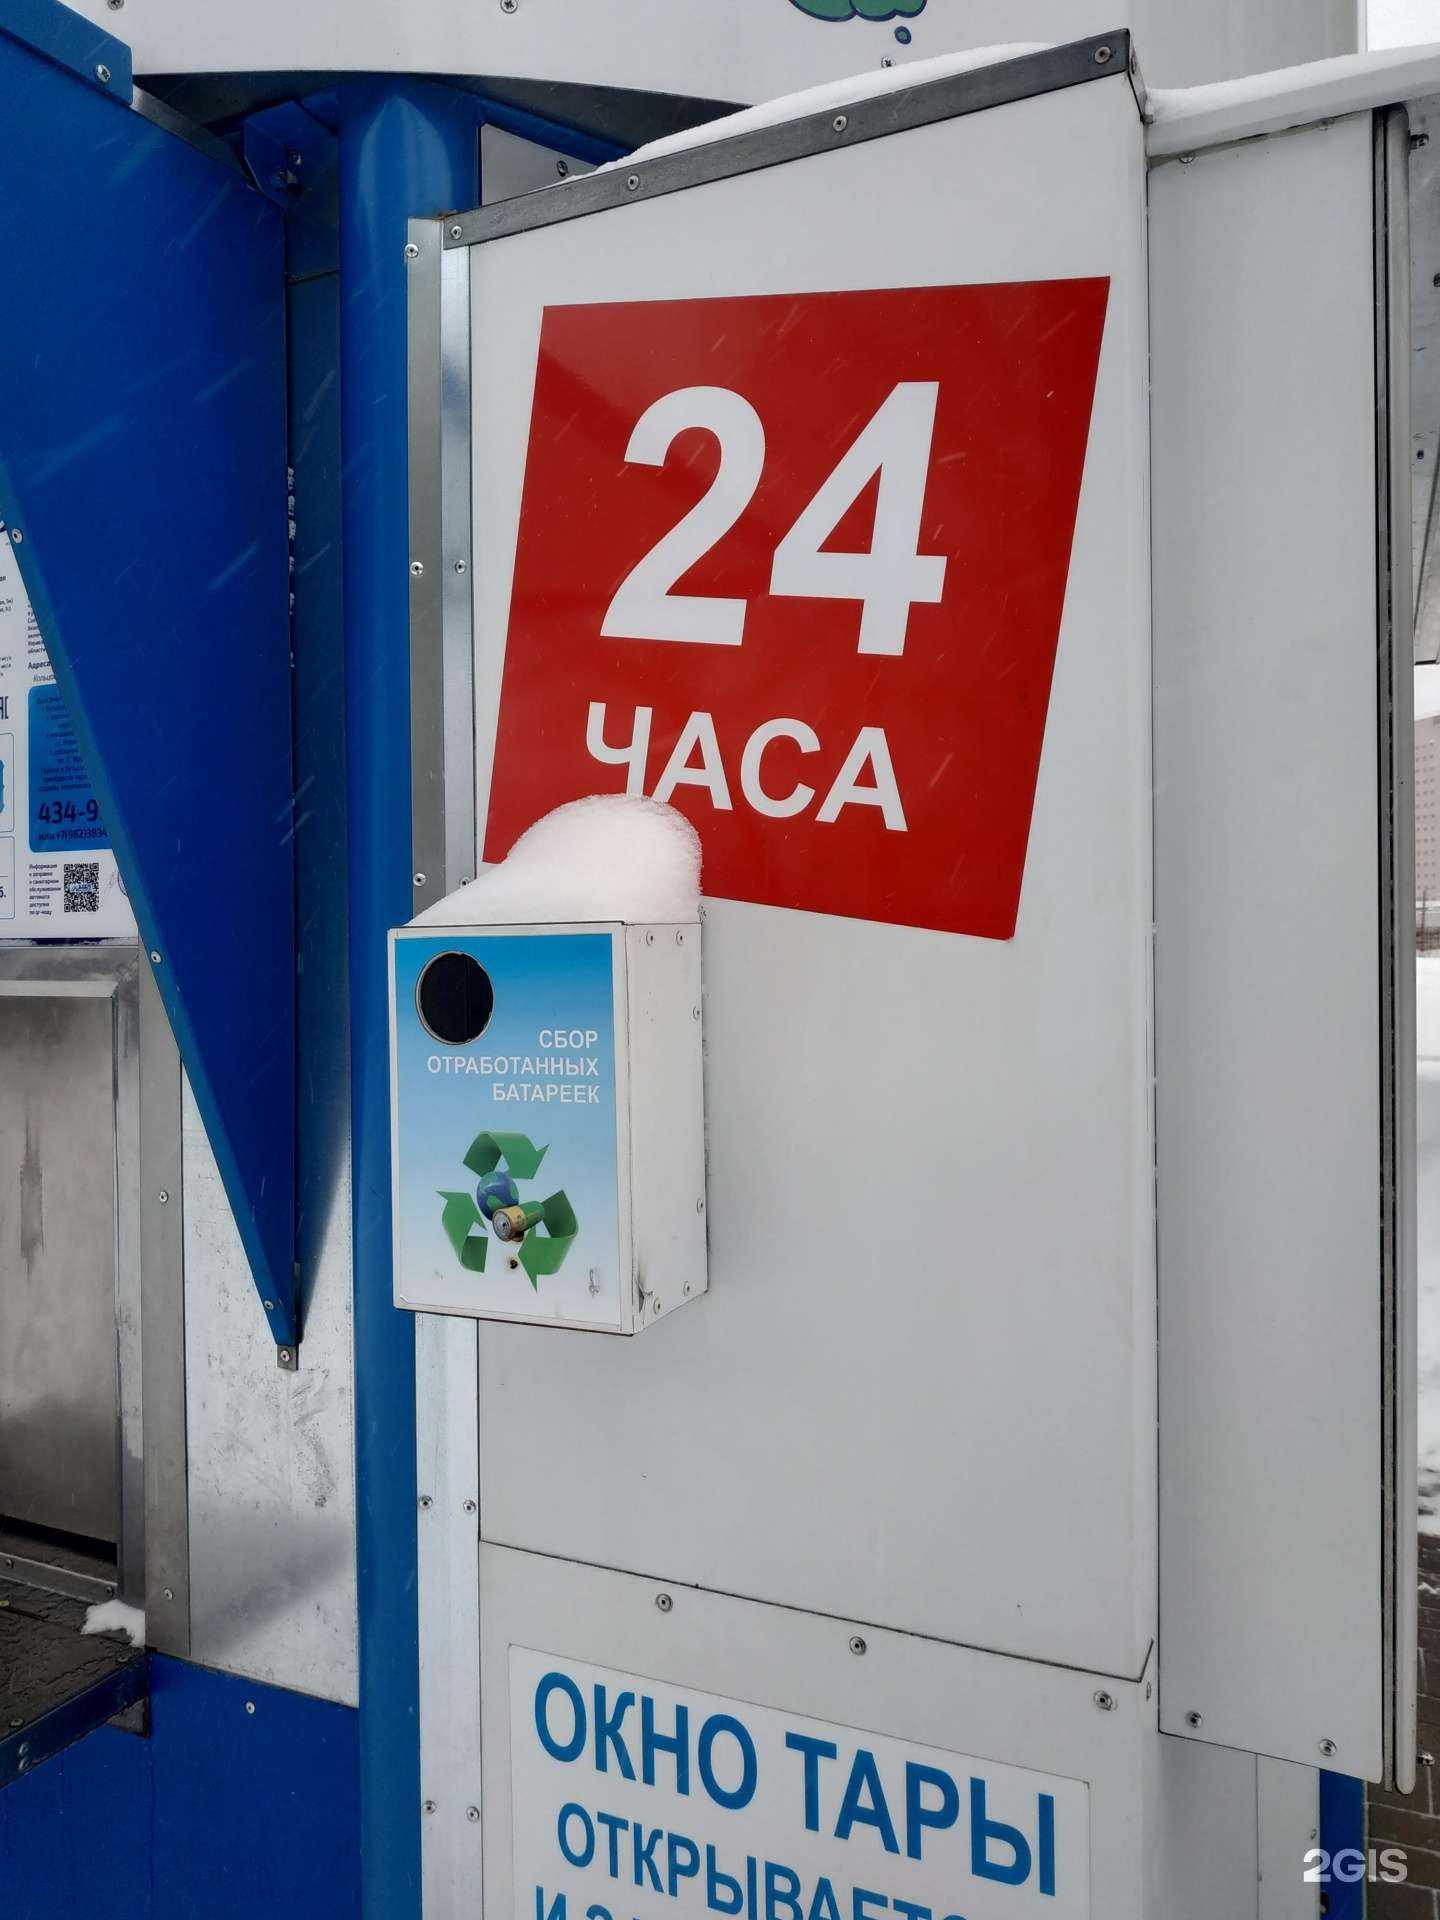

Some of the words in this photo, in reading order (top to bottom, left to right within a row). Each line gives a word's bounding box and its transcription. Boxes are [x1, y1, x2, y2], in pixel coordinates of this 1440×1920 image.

[600, 381, 947, 656] 24
[586, 701, 907, 832] ЧАСА
[427, 1056, 599, 1076] ОТРАБОТАННЫХ
[539, 1030, 598, 1049] СБОР
[493, 1083, 600, 1104] БАТАРЕЕК
[534, 1671, 757, 1810] ОКНО
[785, 1731, 1056, 1897] ТАРЫ
